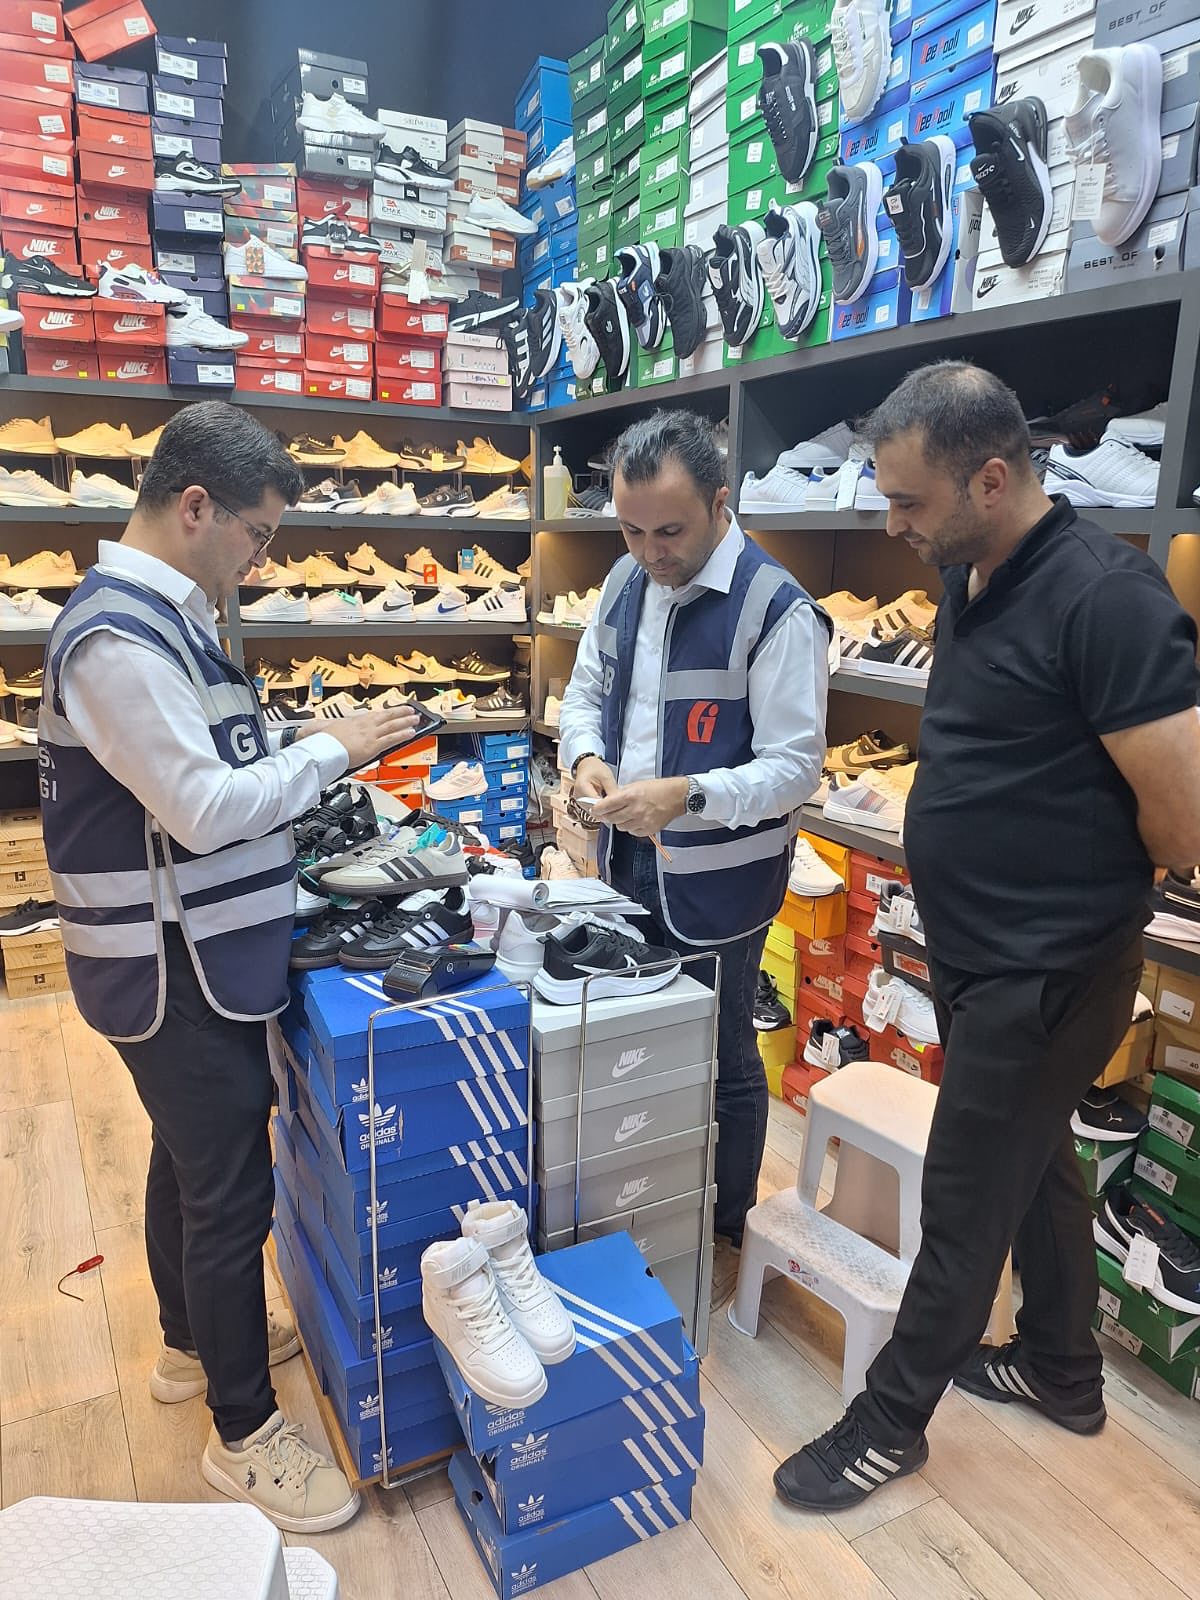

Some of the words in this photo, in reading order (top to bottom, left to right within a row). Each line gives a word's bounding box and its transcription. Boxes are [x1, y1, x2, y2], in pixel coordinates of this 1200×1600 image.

[1014, 4, 1036, 24] NIKE
[1108, 10, 1142, 31] BEST
[1149, 1, 1168, 15] OF
[998, 81, 1018, 100] NIKE
[100, 206, 120, 217] NIKE
[30, 239, 58, 252] NIKE
[1083, 256, 1114, 270] BEST
[1121, 250, 1139, 262] OF
[980, 274, 999, 290] NIKE
[47, 311, 75, 325] NIKE
[121, 314, 147, 328] NIKE
[124, 361, 149, 374] NIKE
[230, 723, 258, 762] G
[1181, 1009, 1191, 1017] 44
[618, 1047, 647, 1067] NIKE
[1189, 1062, 1199, 1070] 40
[620, 1111, 648, 1131] NIKE
[622, 1177, 649, 1196] NIKE
[487, 1410, 526, 1429] adidas
[488, 1420, 525, 1437] ORIGINALS
[510, 1448, 547, 1465] adidas
[518, 1508, 545, 1523] adidas
[511, 1575, 537, 1591] adidas
